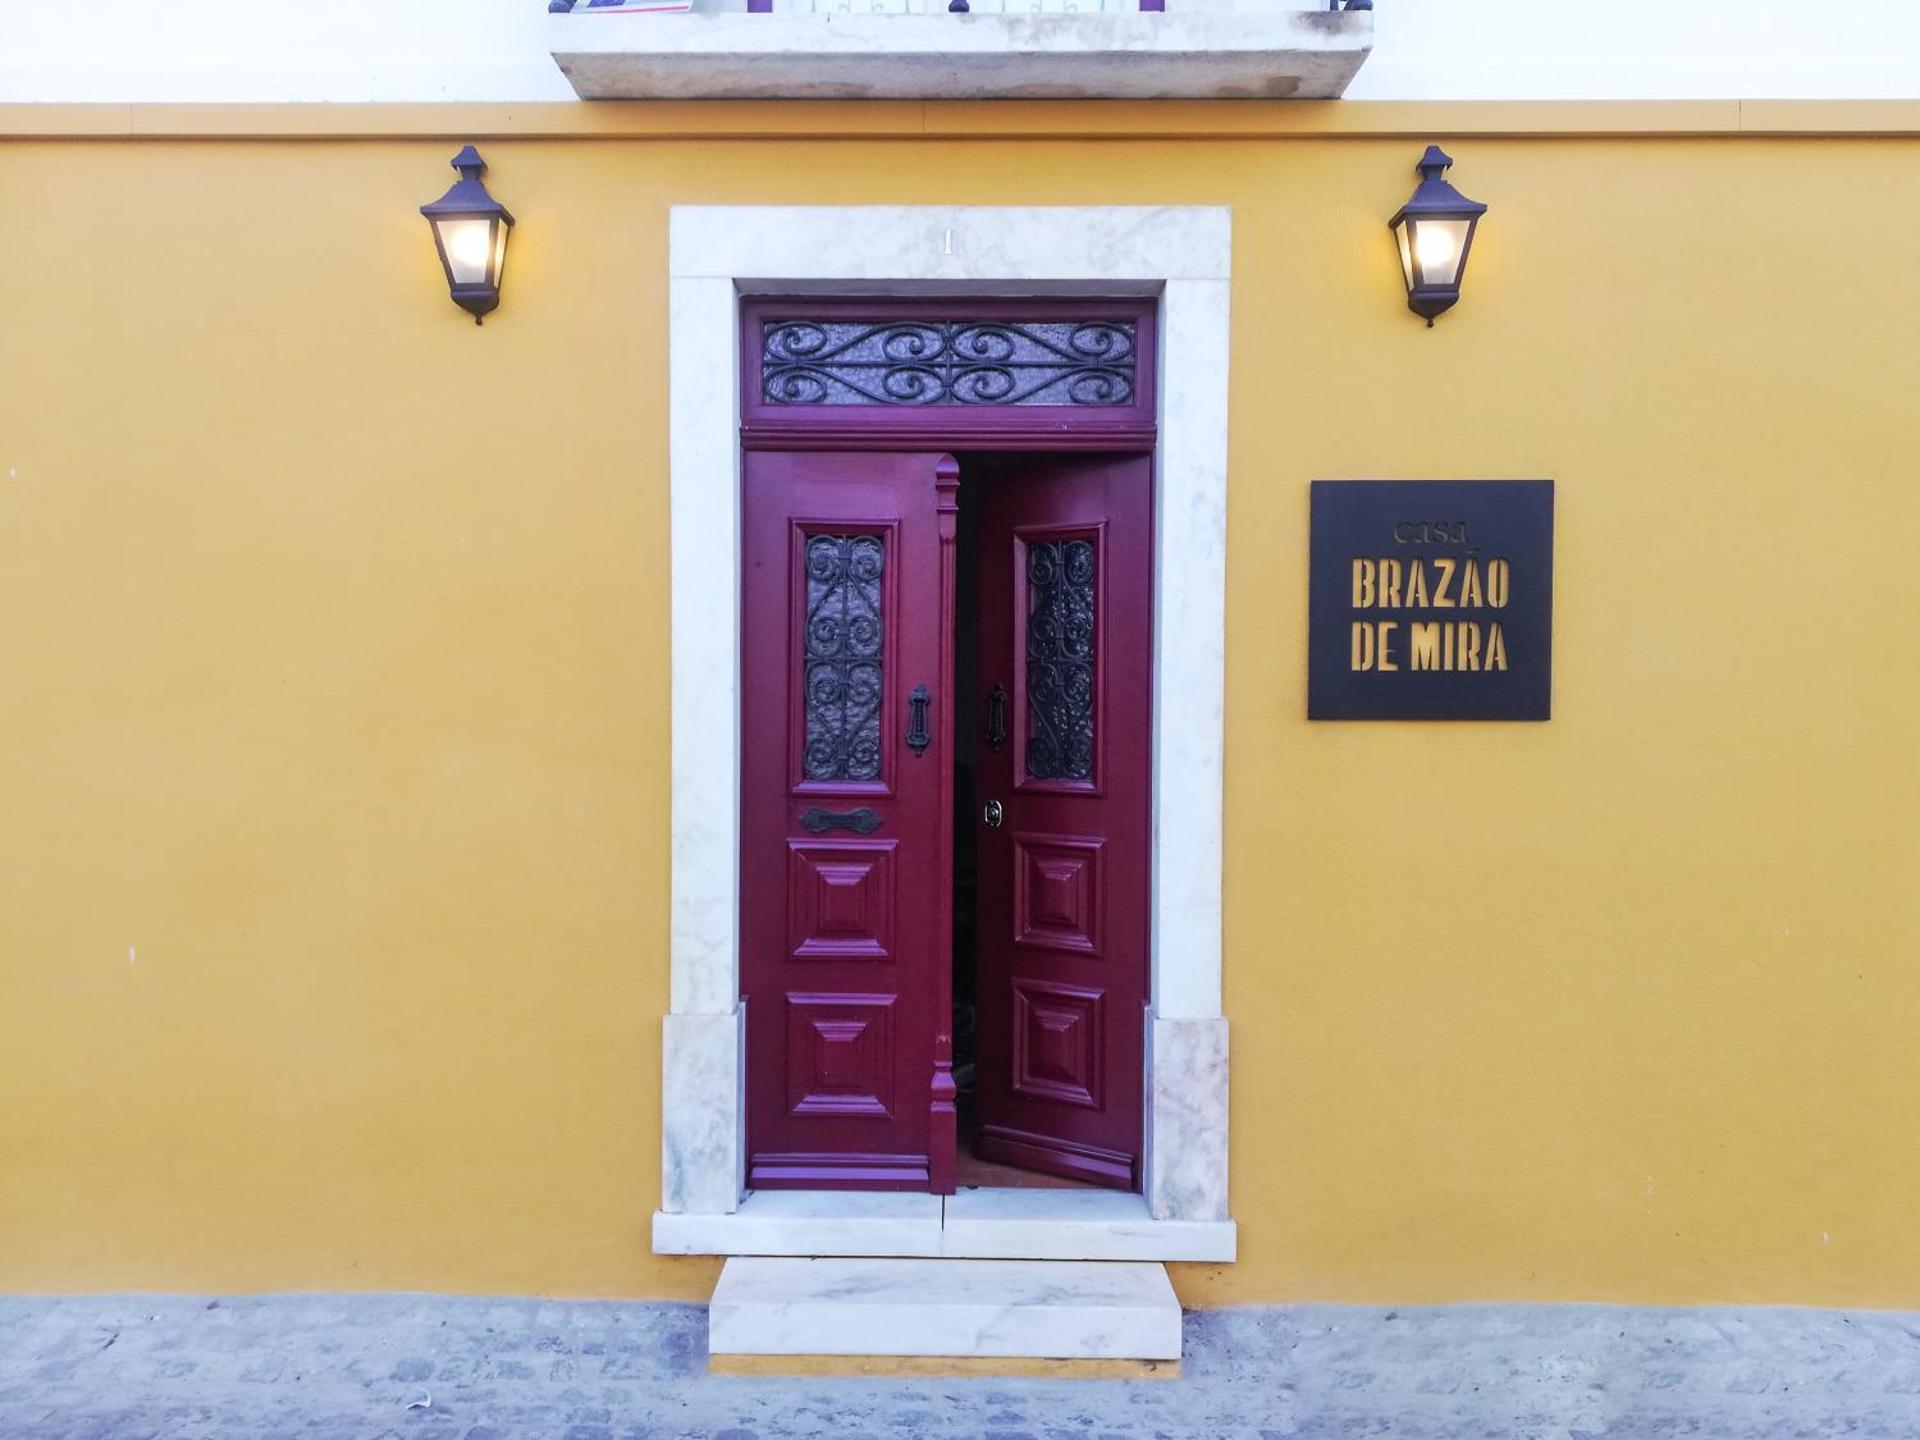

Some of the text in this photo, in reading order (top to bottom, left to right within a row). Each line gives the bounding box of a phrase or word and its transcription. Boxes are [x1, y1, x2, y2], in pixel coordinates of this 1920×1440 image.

[1352, 548, 1510, 608] BRAZÃO
[1352, 621, 1508, 671] DE MIRA
